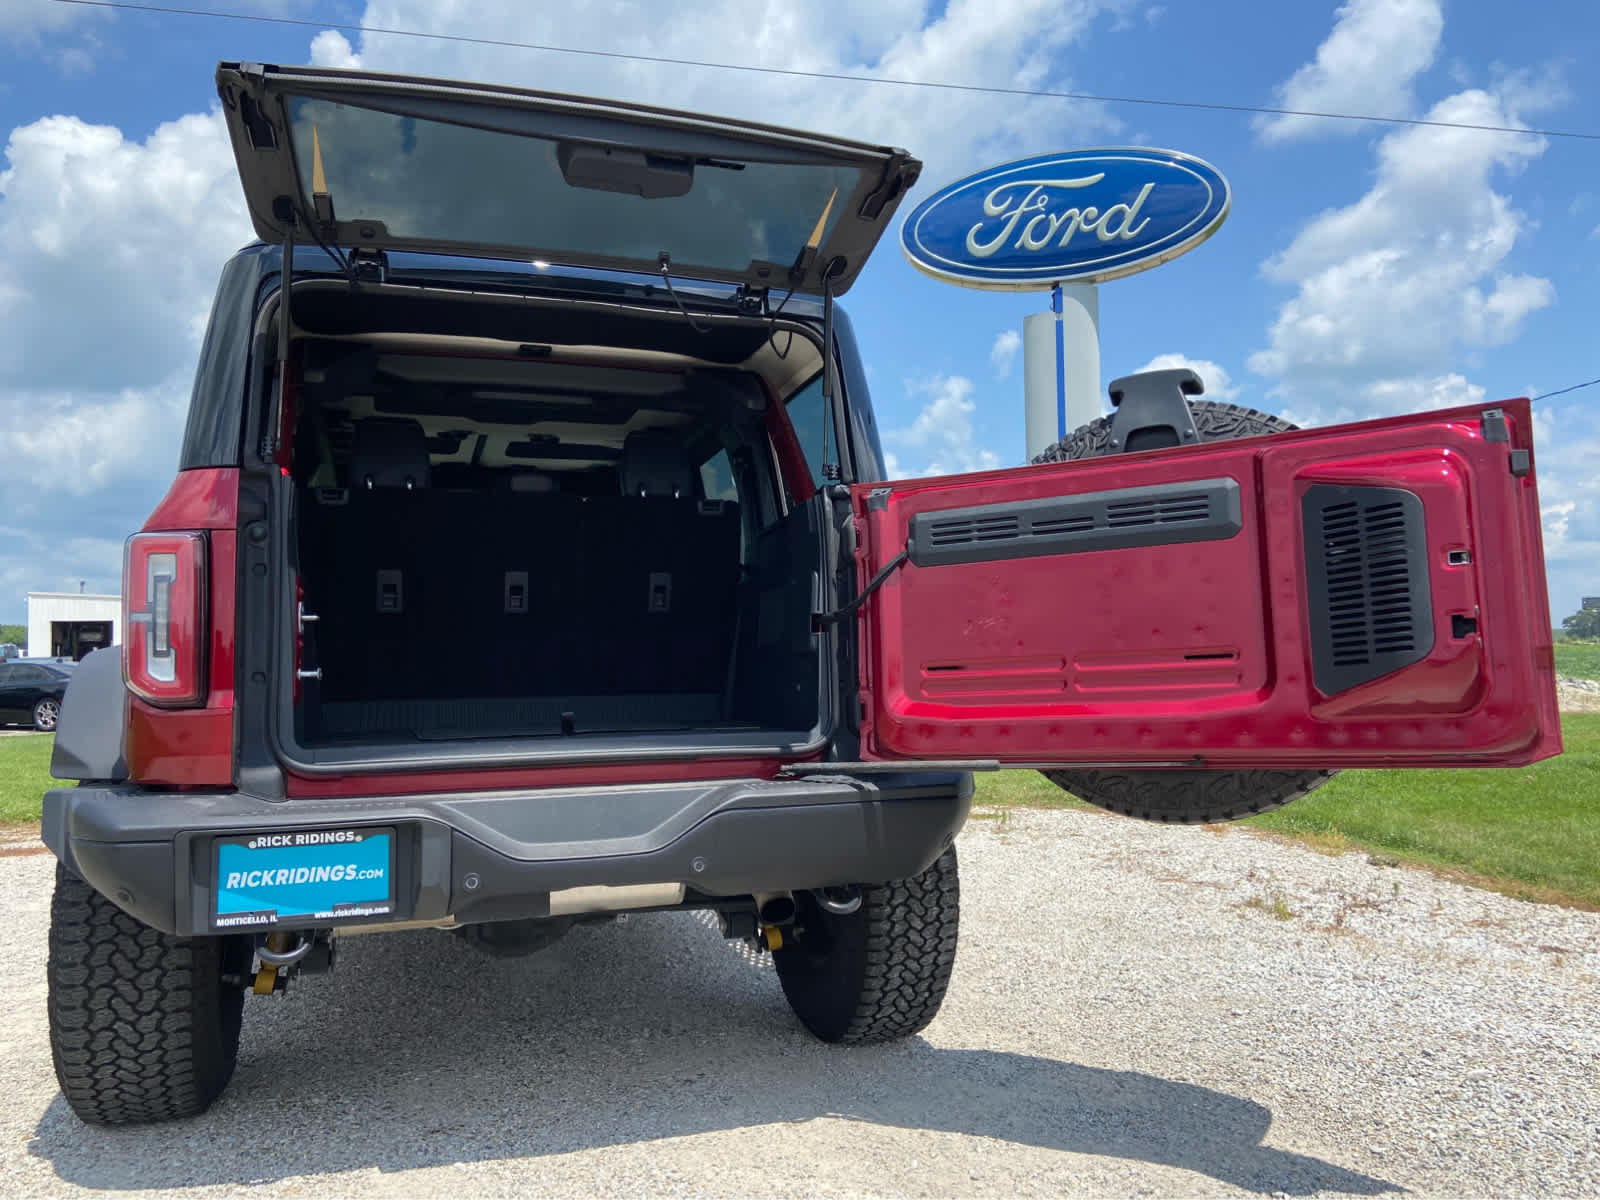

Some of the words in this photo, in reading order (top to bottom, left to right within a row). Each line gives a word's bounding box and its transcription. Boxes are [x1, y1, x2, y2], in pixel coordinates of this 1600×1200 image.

[966, 172, 1155, 258] Ford
[257, 834, 292, 848] RICK
[295, 831, 355, 845] RIDINGS
[226, 864, 384, 889] RICKRIDINGS.COM
[216, 915, 269, 927] MONTICELLO,
[270, 914, 278, 923] IL
[314, 906, 390, 919] www.rickridings.com
